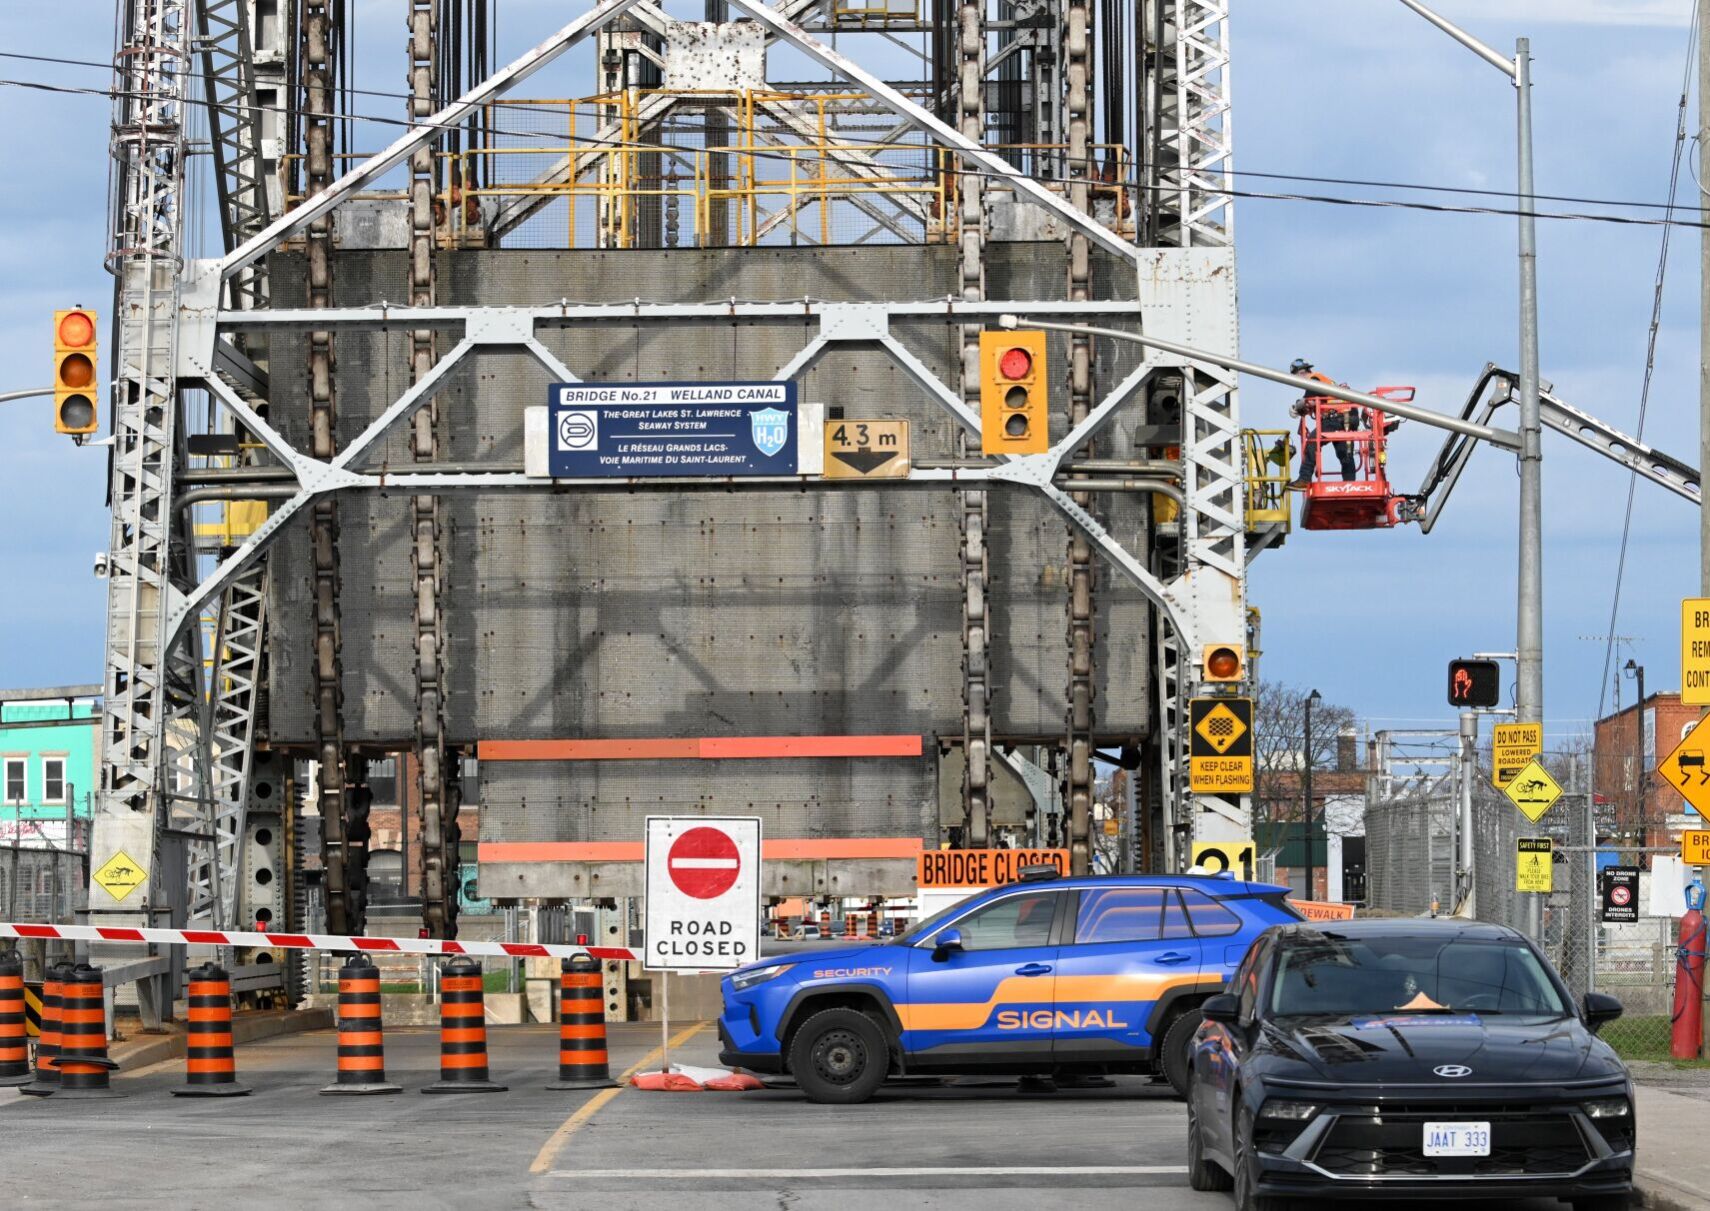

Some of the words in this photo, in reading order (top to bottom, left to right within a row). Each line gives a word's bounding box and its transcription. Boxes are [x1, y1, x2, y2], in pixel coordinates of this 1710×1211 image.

[566, 391, 617, 401] BRIDGE
[621, 390, 657, 400] No.21
[671, 390, 733, 400] WELLAND
[738, 389, 782, 399] CANAL
[652, 410, 678, 418] LAKES
[680, 410, 693, 418] ST.
[696, 410, 742, 418] LAWRENCE
[674, 422, 707, 430] SYSTEM
[756, 426, 784, 448] H2O
[832, 424, 870, 446] 4.3
[879, 434, 896, 446] m
[618, 444, 628, 452] LE
[630, 442, 664, 452] RÉSEAU
[666, 444, 702, 452] GRANDS
[600, 456, 620, 464] VOIE
[622, 456, 664, 464] MARITIME
[665, 456, 678, 464] DU
[680, 456, 746, 464] SAINT-LAURENT
[1325, 483, 1374, 493] SKYJACK
[1498, 731, 1506, 744] DO
[1508, 730, 1520, 744] NOT
[1522, 730, 1536, 743] PASS
[1200, 762, 1218, 771] KEEP
[1220, 762, 1243, 771] CLEAR
[1194, 775, 1214, 785] WHEN
[1216, 774, 1250, 785] FLASHING
[924, 853, 988, 884] BRIDGE
[1298, 908, 1344, 919] DEWALK
[670, 920, 732, 935] ROAD
[657, 940, 746, 956] CLOSED
[813, 967, 892, 978] SECURITY
[997, 1009, 1128, 1030] SIGNAL
[1427, 1132, 1456, 1148] JAAT
[1464, 1132, 1487, 1147] 333
